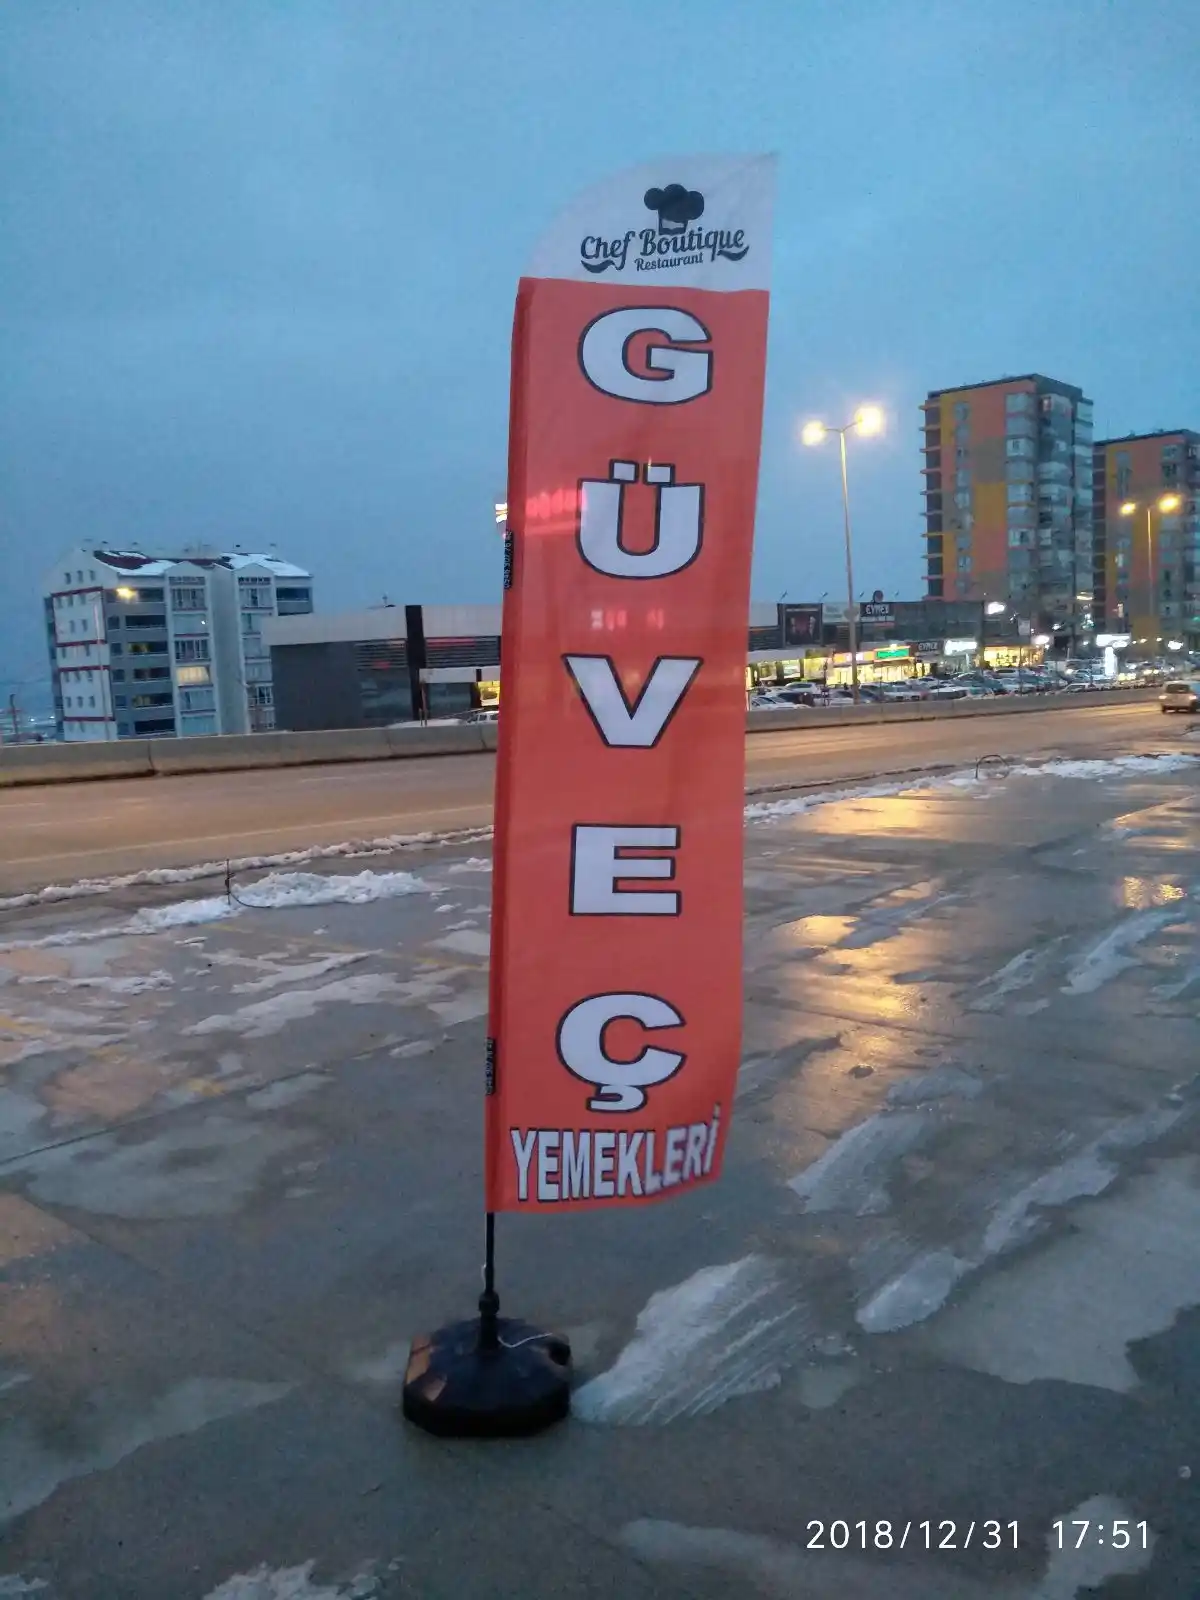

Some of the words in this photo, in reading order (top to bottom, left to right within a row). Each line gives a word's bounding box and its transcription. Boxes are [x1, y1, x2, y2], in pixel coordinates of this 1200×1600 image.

[581, 229, 636, 273] Chef
[639, 226, 749, 262] Boutique
[635, 252, 704, 271] Restaurant
[557, 306, 713, 1112] GÜVEÇ
[510, 1103, 721, 1202] YEMEKLERİ
